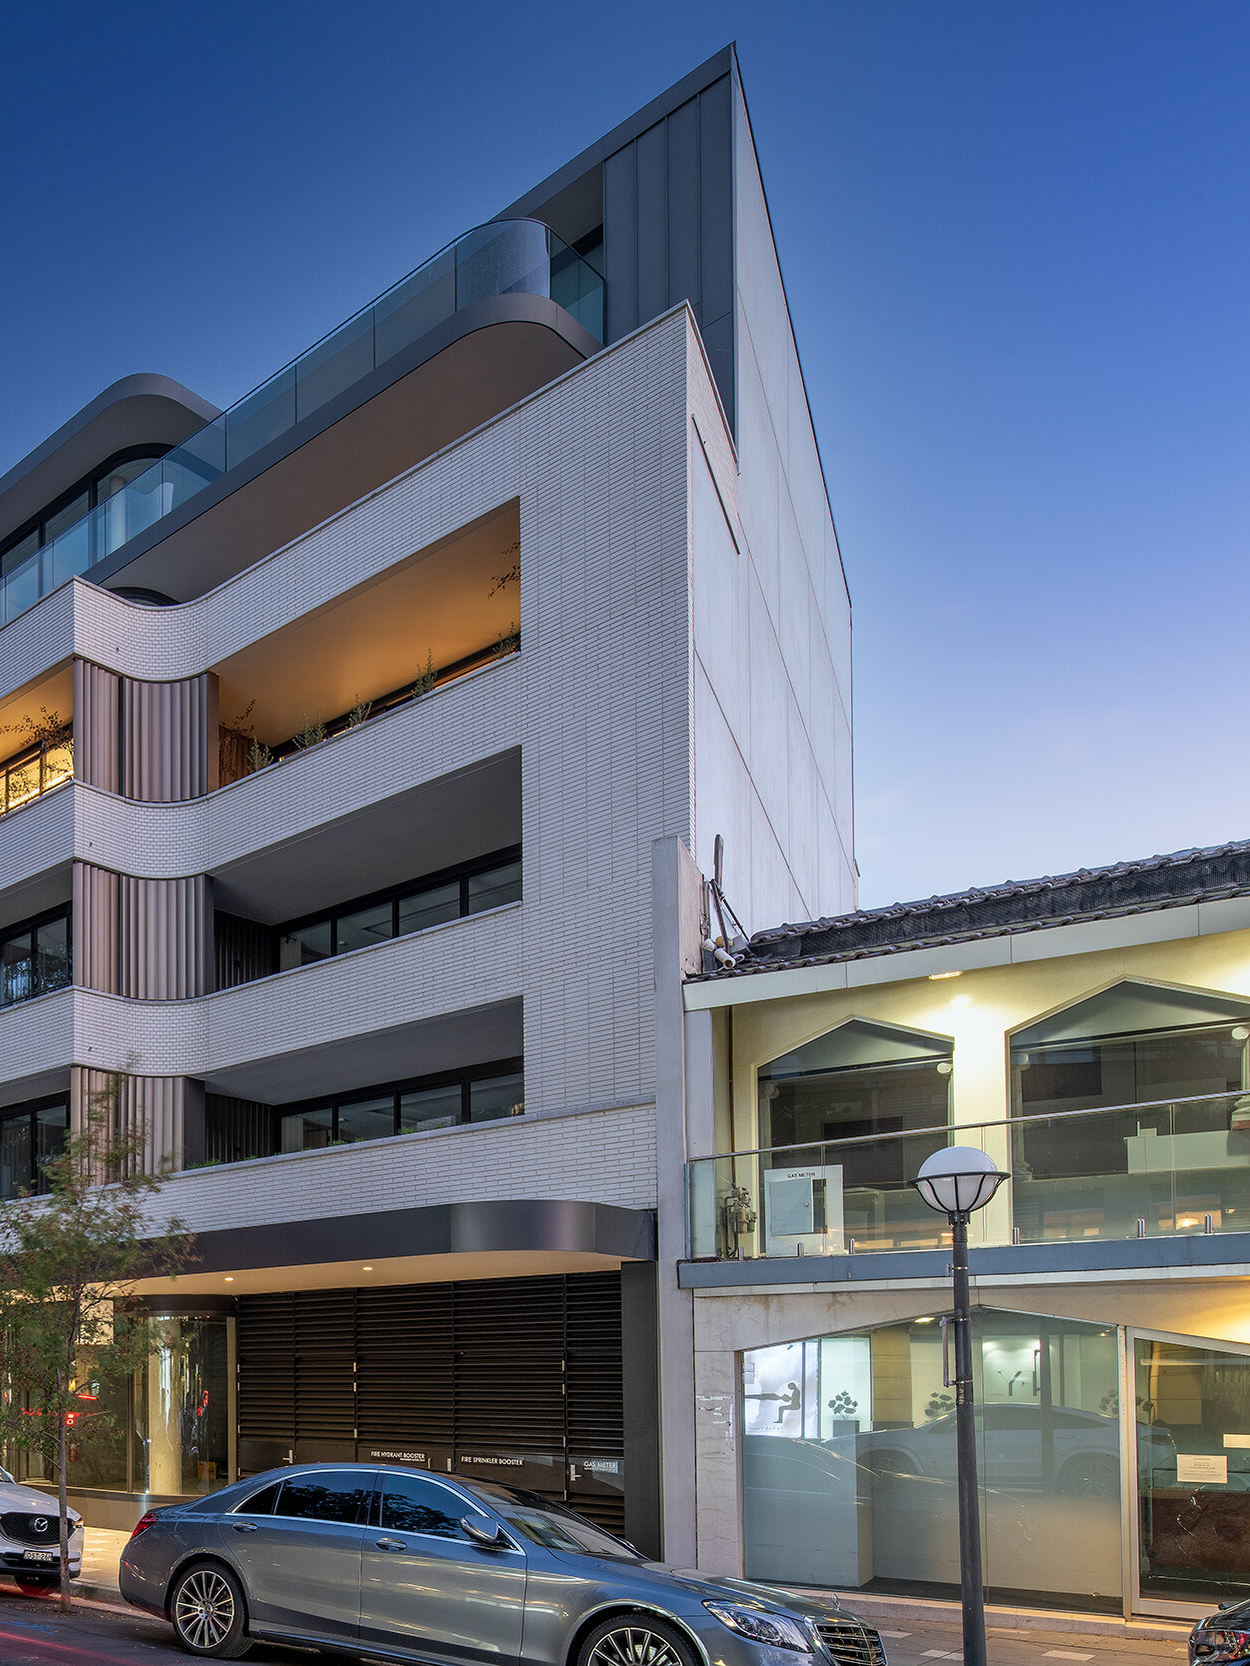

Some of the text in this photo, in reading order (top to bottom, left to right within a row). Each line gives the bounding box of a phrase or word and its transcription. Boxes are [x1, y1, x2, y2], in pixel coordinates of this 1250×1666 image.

[381, 1451, 403, 1459] HYDRANT
[461, 1455, 524, 1466] FIRE SPRINKLER BOOSTER
